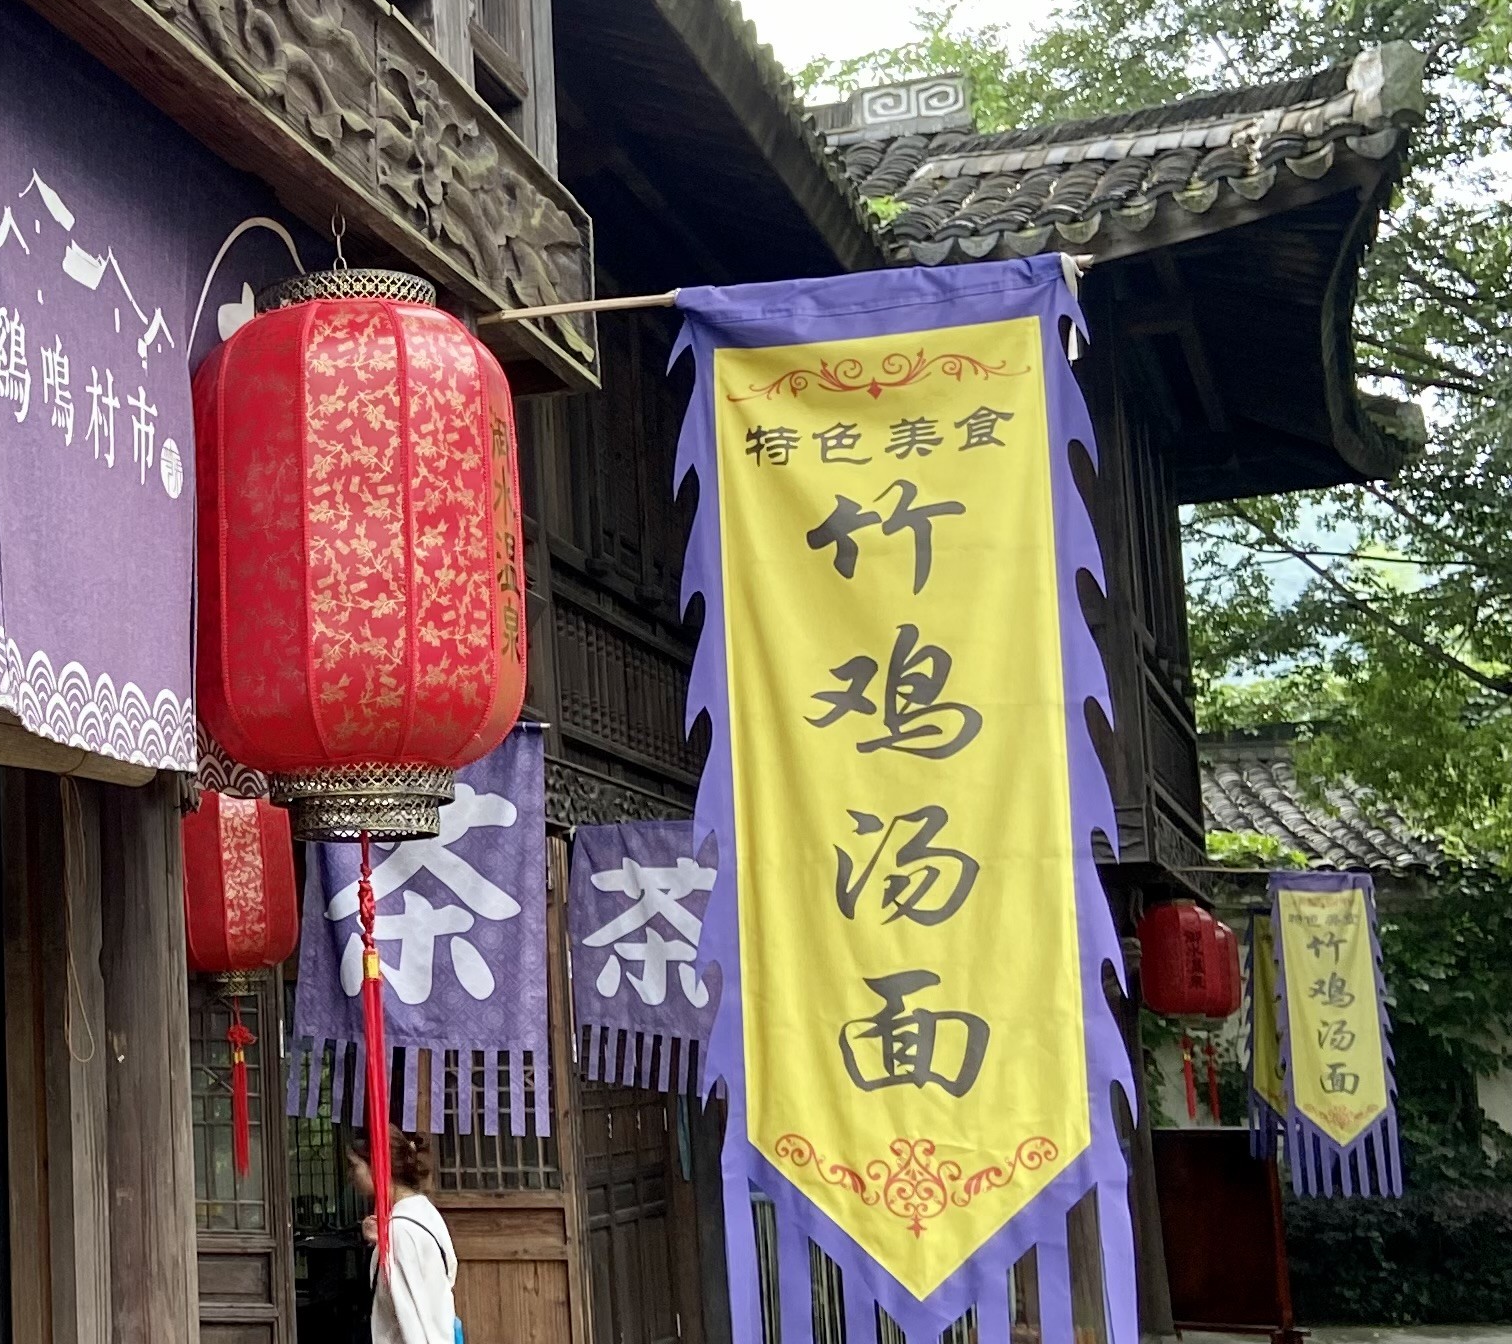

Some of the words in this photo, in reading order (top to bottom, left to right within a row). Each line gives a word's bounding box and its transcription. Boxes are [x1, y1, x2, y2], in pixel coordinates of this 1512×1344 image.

[745, 406, 1015, 468] 特色美食
[803, 479, 990, 1099] 竹鸡汤面
[324, 782, 522, 1005] 茶
[582, 857, 719, 1008] 茶
[1307, 931, 1360, 1095] 竹鸡汤面
